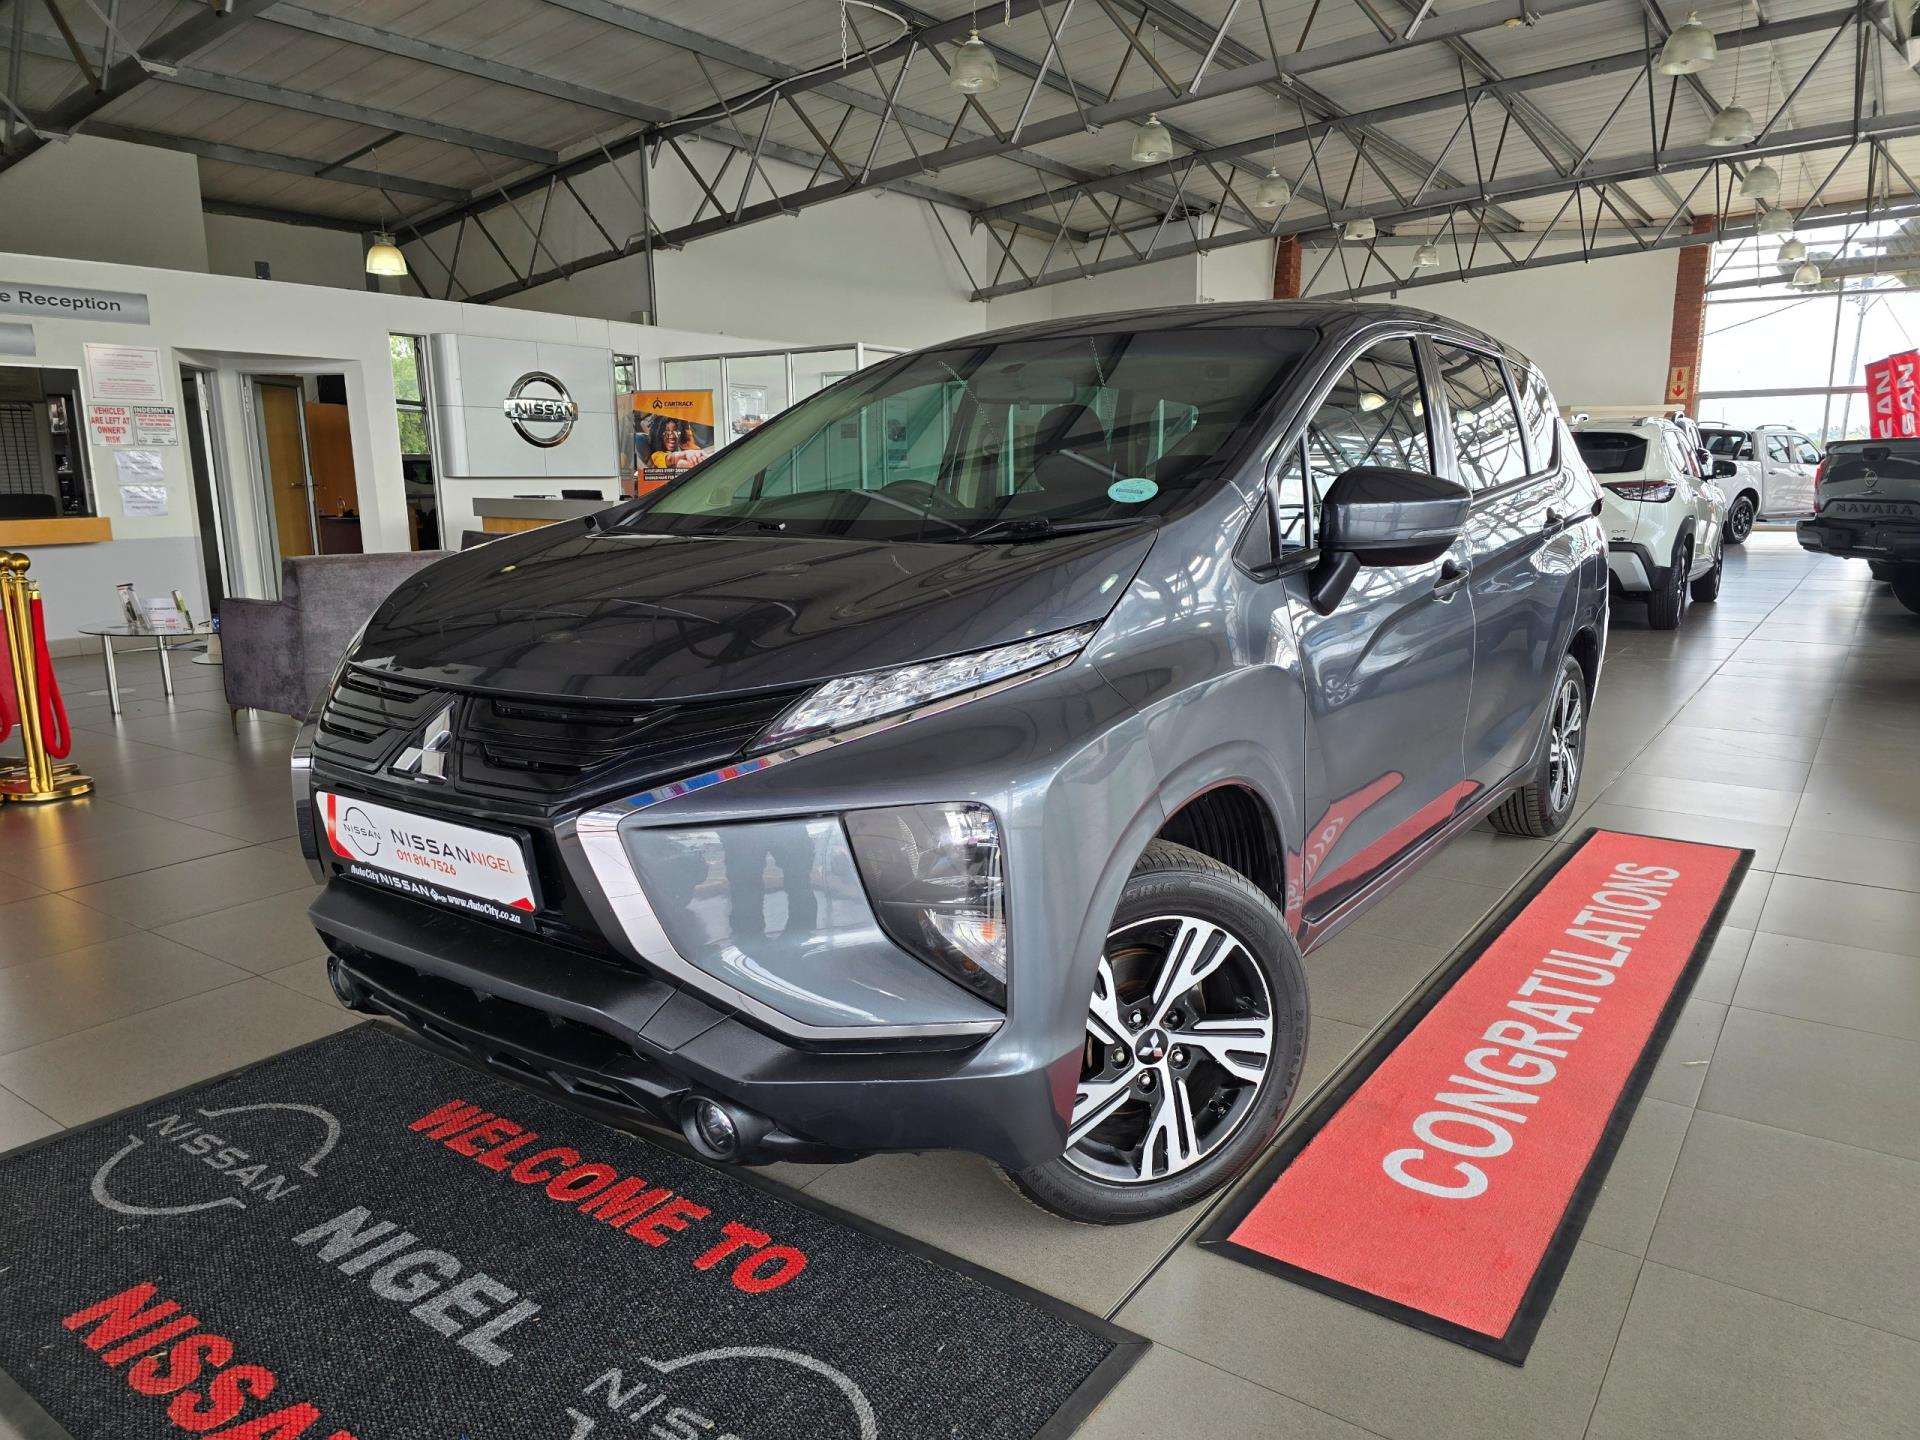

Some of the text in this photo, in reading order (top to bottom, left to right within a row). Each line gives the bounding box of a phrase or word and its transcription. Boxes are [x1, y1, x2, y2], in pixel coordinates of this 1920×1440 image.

[18, 291, 121, 312] Reception
[93, 407, 126, 415] VEHICLES
[133, 406, 174, 414] INDEMNITY
[514, 402, 574, 417] NISSAN
[91, 416, 130, 425] ARE LEFT AT
[97, 426, 126, 434] OWNER'S
[105, 435, 120, 443] RISK
[1835, 503, 1914, 515] NAVARA
[343, 823, 382, 840] NISSAN
[350, 864, 379, 884] AutoCity
[379, 872, 430, 897] NISSAN
[1381, 861, 1681, 1199] CONGRATULATIONS
[147, 1115, 300, 1201] NISSAN
[408, 1099, 808, 1294] WELCOME TO
[291, 1205, 542, 1366] NIGEL
[61, 1281, 363, 1440] NISSA
